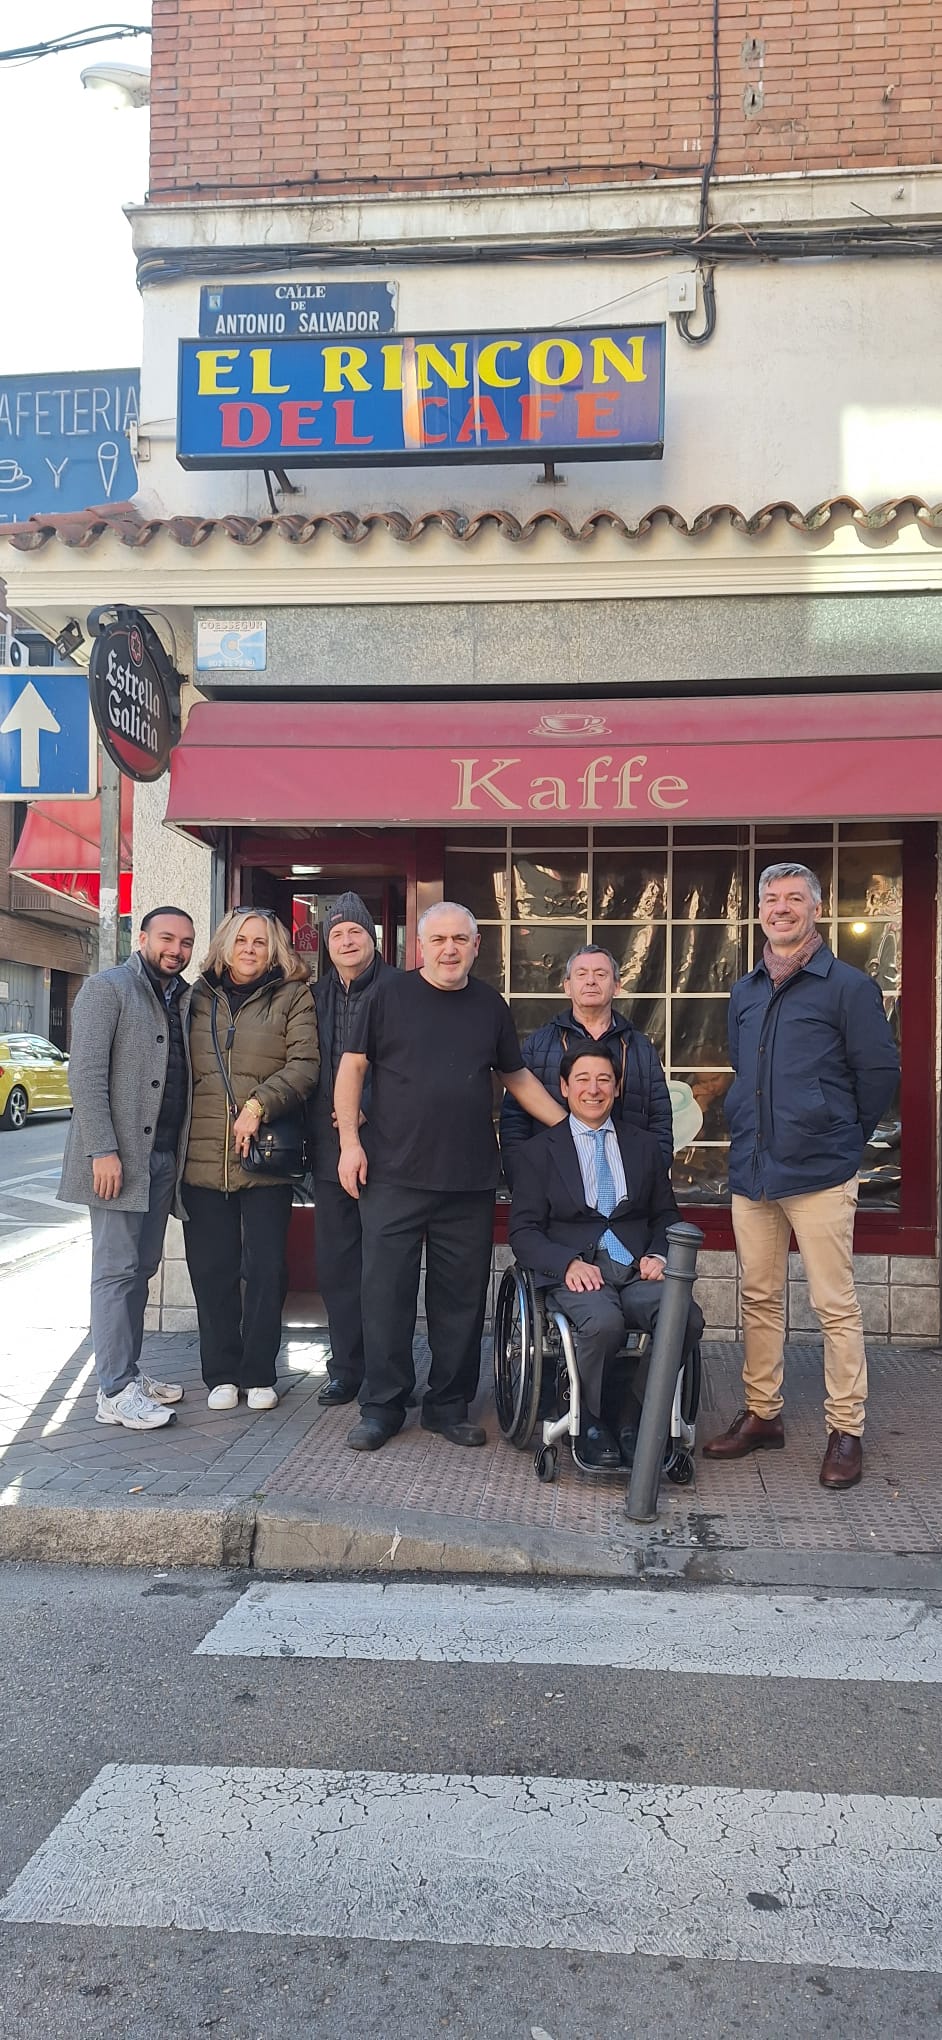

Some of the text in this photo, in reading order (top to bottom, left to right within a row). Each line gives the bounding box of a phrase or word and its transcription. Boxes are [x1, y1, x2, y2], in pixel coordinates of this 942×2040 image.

[275, 285, 326, 299] CALLE
[290, 301, 306, 311] DE
[215, 310, 380, 335] ANTONIO SALVADOR
[195, 336, 648, 395] EL RINCON
[0, 386, 140, 436] AFETERIA
[218, 390, 622, 447] DEL CAFE
[45, 457, 69, 489] Y
[106, 649, 161, 719] Estrella
[108, 689, 159, 753] Galicia
[450, 755, 689, 810] Kaffe
